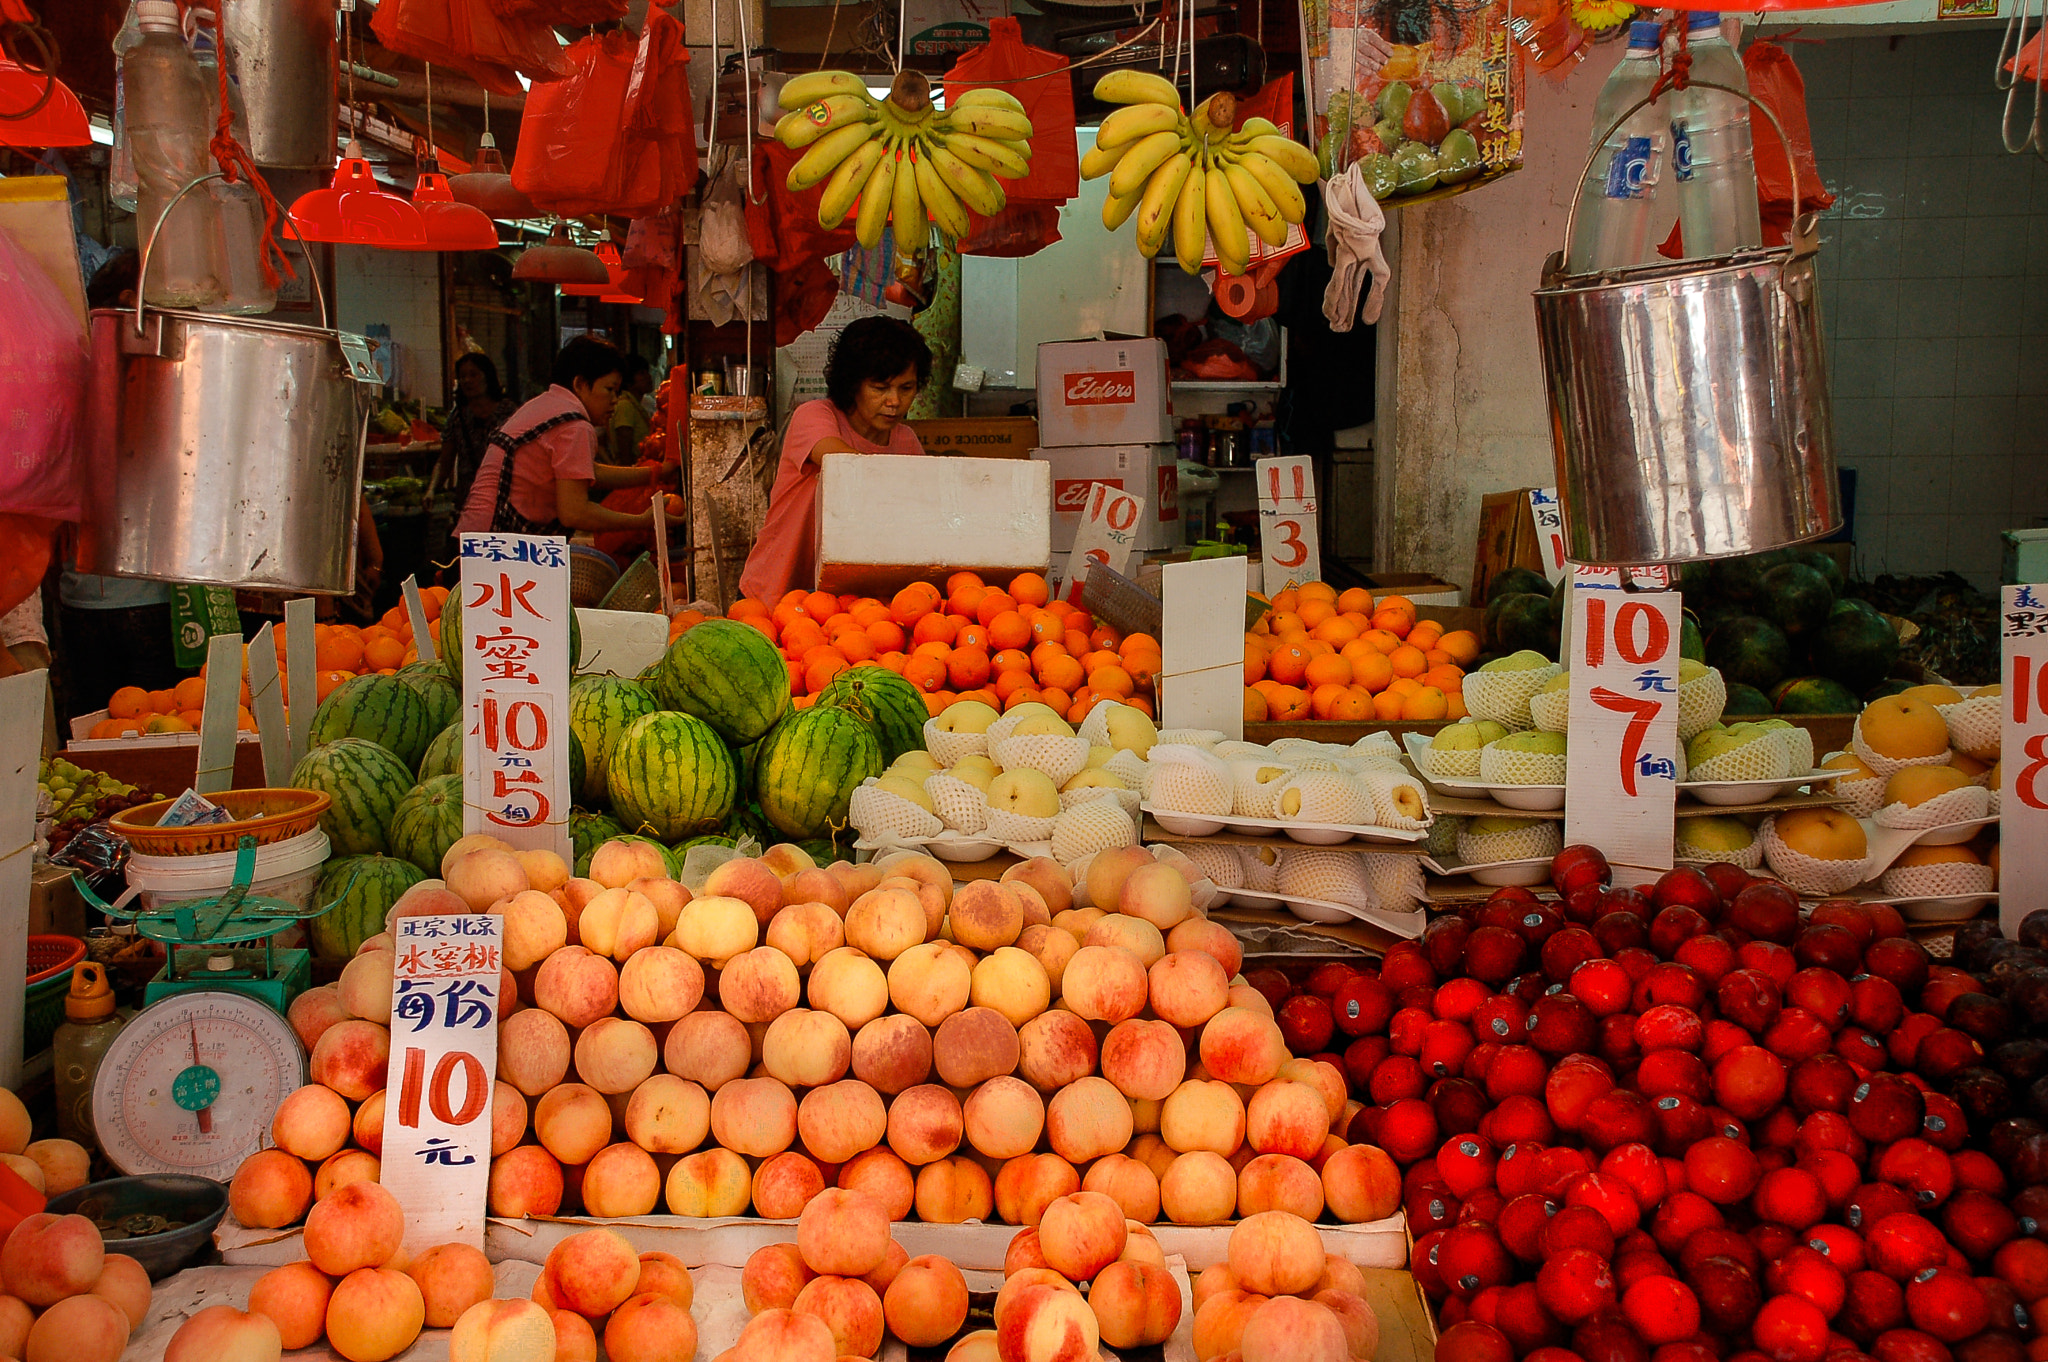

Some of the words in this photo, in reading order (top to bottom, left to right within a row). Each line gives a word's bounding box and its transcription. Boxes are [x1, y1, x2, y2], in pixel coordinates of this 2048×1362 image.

[1067, 376, 1132, 400] Elders
[955, 434, 1012, 445] PRODUCE
[1268, 465, 1304, 507] 11
[1090, 486, 1138, 531] 10
[461, 536, 566, 568] 正宗北京
[1271, 520, 1308, 568] 3
[465, 572, 551, 685] 水蜜
[1586, 598, 1670, 669] 10
[1633, 669, 1677, 692] 元
[483, 698, 548, 753] 10
[1590, 686, 1663, 797] 7
[498, 752, 533, 768] 元
[486, 770, 550, 828] 5
[399, 916, 497, 938] 正宗北京
[398, 942, 500, 974] 水蜜桃
[393, 980, 496, 1033] 每份
[399, 1047, 489, 1129] 10
[415, 1138, 477, 1166] 元
